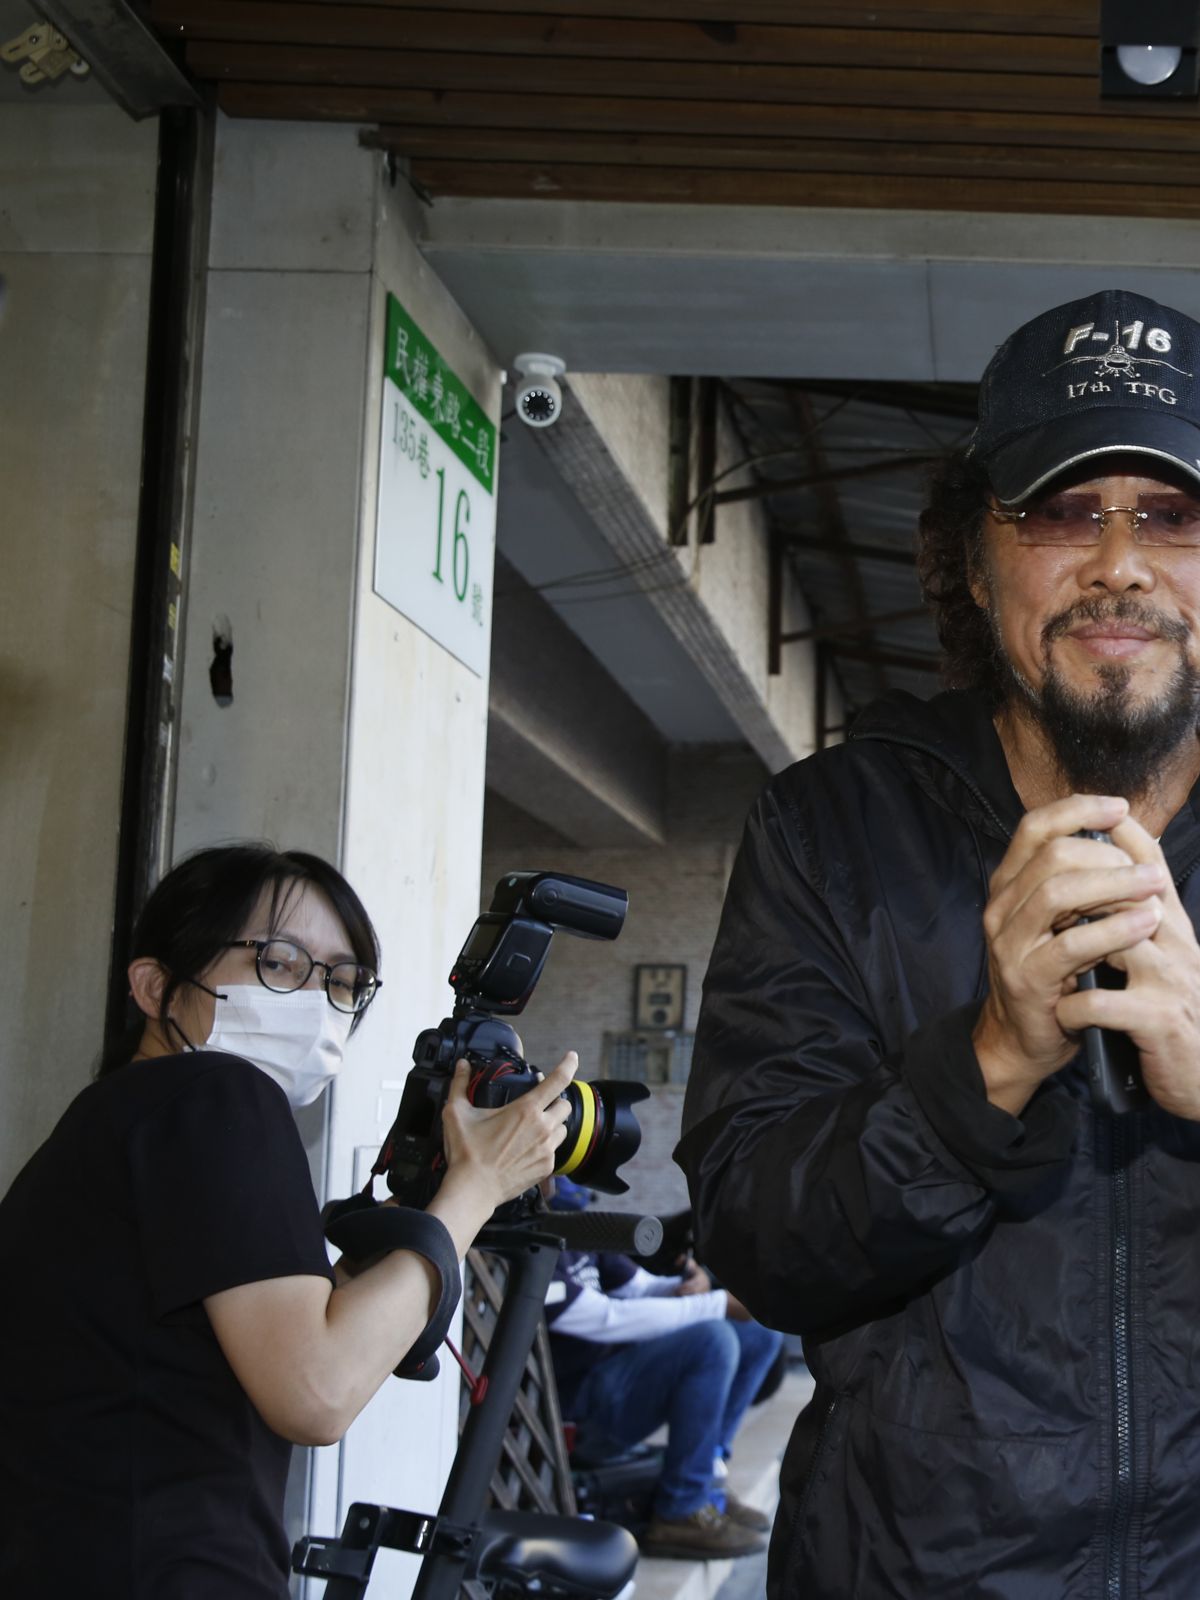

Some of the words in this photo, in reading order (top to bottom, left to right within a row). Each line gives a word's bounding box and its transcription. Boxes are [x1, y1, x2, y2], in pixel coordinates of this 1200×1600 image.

[1064, 320, 1172, 354] F-16
[1067, 381, 1111, 399] 17th
[1124, 381, 1178, 405] TFG
